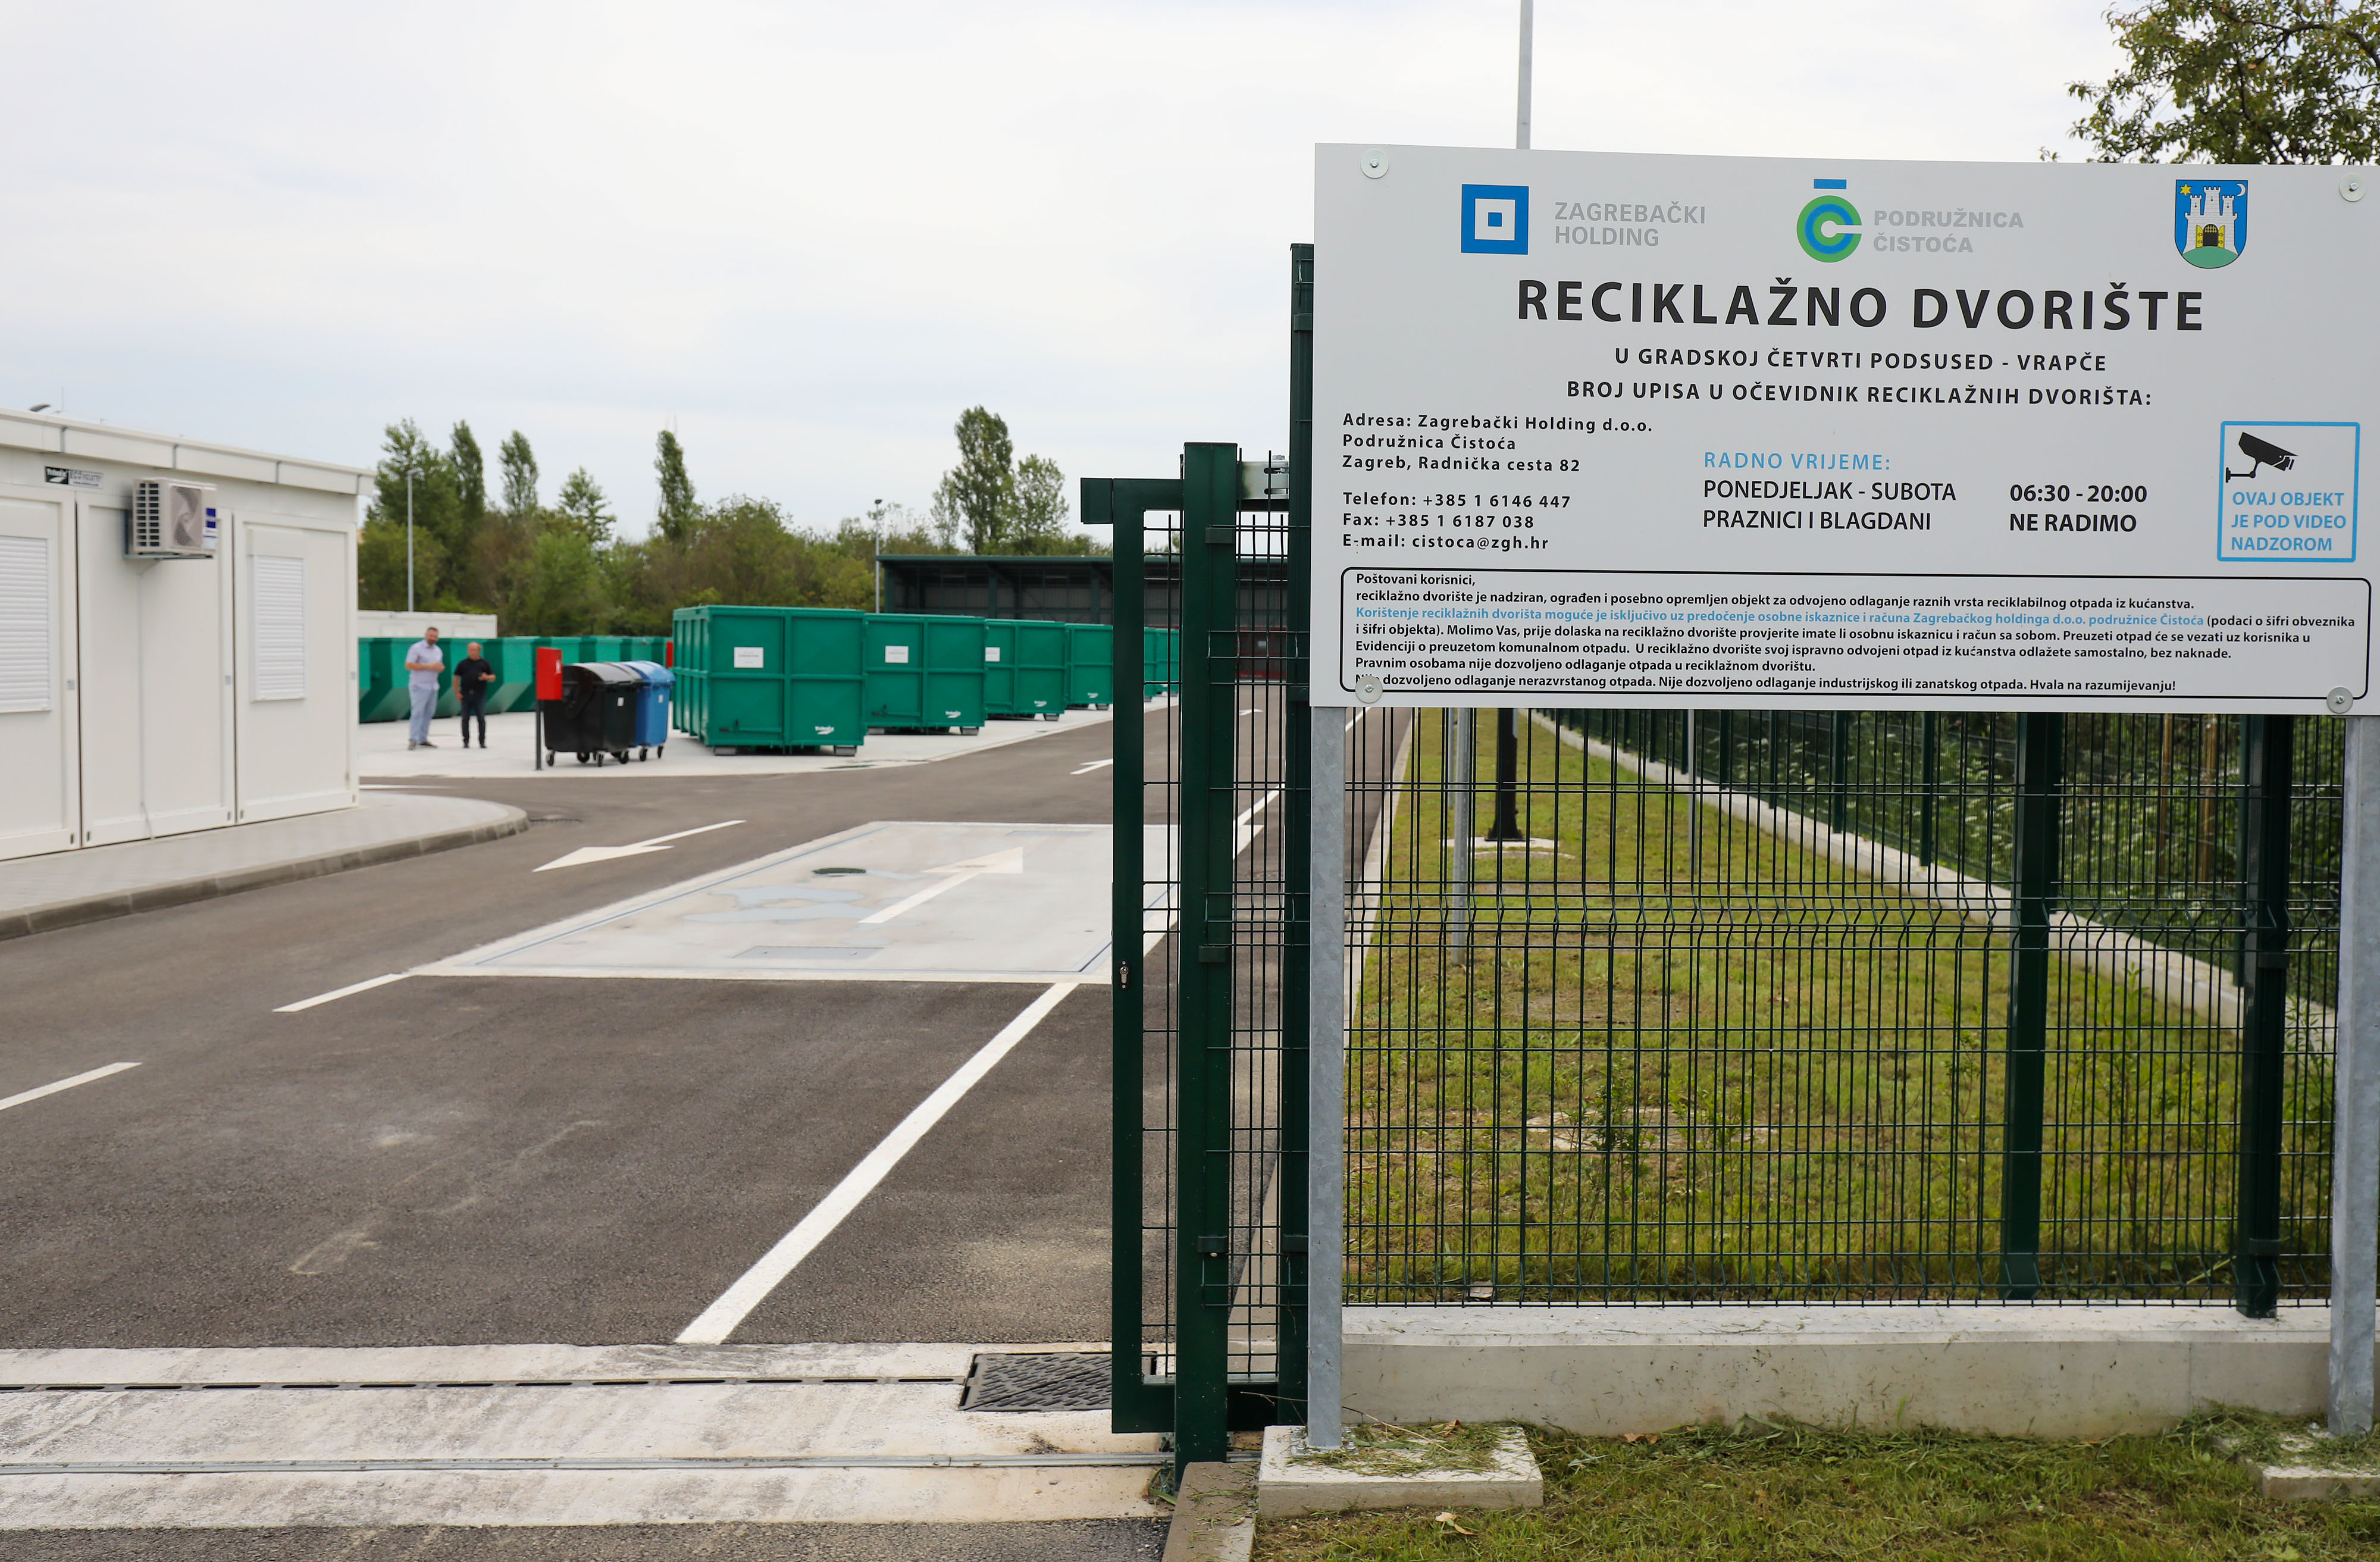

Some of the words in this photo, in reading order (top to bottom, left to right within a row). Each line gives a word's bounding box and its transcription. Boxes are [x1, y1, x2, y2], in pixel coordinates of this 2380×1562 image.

[1554, 201, 1705, 224] ZAGREBAČKI
[1874, 208, 2024, 228] PODRUŽNICA
[1555, 226, 1659, 247] HOLDING
[1873, 231, 1974, 253] ČISTOĆA
[1518, 278, 1887, 328] RECIKLAŽNO
[1914, 281, 2202, 331] DVORIŠTE
[1615, 348, 1629, 364] U
[1638, 348, 1758, 367] GRADSKOJ
[1767, 348, 1861, 368] ČETVRTI
[1871, 352, 1993, 370] PODSUSED
[2017, 352, 2106, 371] VRAPČE
[1567, 381, 1623, 398] BROJ
[1633, 382, 1700, 399] UPISA
[1709, 384, 1723, 400] U
[1732, 381, 1858, 402] OČEVIDNIK
[1868, 384, 2019, 404] RECIKLAŽNIH
[2029, 386, 2151, 406] DVORIŠTA:
[1342, 412, 1411, 427] Adresa:
[1417, 414, 1518, 431] Zagrebački
[1526, 417, 1595, 434] Holding
[1602, 418, 1652, 432] d.o.o.
[1343, 434, 1443, 449] Podružnica
[1451, 433, 1515, 450] Čistoća
[1342, 455, 1411, 472] Zagreb,
[1418, 456, 1500, 470] Radnička
[1507, 459, 1552, 471] cesta
[1559, 459, 1579, 472] 82
[1705, 452, 1783, 469] RADNO
[1790, 453, 1890, 471] VRIJEME:
[1704, 480, 1853, 500] PONEDJELJAK
[1871, 482, 1956, 500] SUBOTA
[2010, 484, 2070, 502] 06:30
[2087, 485, 2147, 503] 20:00
[2232, 492, 2276, 506] OVAJ
[2281, 492, 2345, 506] OBJEKT
[1342, 492, 1416, 506] Telefon:
[1423, 493, 1466, 506] +385
[1474, 494, 1480, 507] 1
[1489, 494, 1532, 508] 6146
[1539, 496, 1570, 508] 447
[1343, 513, 1379, 526] Fax:
[1386, 514, 1429, 527] +385
[1438, 515, 1443, 527] 1
[1452, 515, 1495, 528] 6187
[1502, 515, 1534, 528] 038
[1703, 509, 1802, 529] PRAZNICI
[1809, 511, 1814, 529] I
[1821, 511, 1930, 530] BLAGDANI
[2010, 514, 2038, 531] NE
[2045, 514, 2137, 533] RADIMO
[2231, 514, 2249, 528] JE
[2253, 514, 2290, 528] POD
[2294, 515, 2347, 529] VIDEO
[1343, 534, 1405, 547] E-mail:
[1412, 534, 1548, 552] cistoca@zgh.hr
[2232, 537, 2332, 551] NADZOROM
[1357, 573, 1417, 584] Poštovani
[1420, 574, 1476, 587] korisnici,
[1356, 590, 1420, 601] reciklažno
[1423, 590, 1473, 602] dvorište
[1475, 591, 1487, 605] je
[1490, 591, 1547, 604] nadziran,
[1550, 592, 1601, 606] ograđen
[1604, 593, 1608, 603] i
[1611, 593, 1664, 606] posebno
[1666, 593, 1728, 607] opremljen
[1731, 594, 1771, 608] objekt
[1789, 594, 1846, 608] odvojeno
[1849, 595, 1910, 609] odlaganje
[1913, 596, 1950, 607] raznih
[1953, 597, 1984, 607] vrsta
[1987, 596, 2066, 611] reciklabilnog
[2069, 597, 2113, 611] otpada
[2116, 597, 2126, 608] iz
[2129, 597, 2194, 609] kućanstva.
[1356, 607, 1419, 621] Korištenje
[1422, 608, 1489, 619] reciklažnih
[1492, 608, 1542, 619] dvorišta
[1545, 609, 1593, 622] moguće
[1595, 609, 1607, 622] je
[1610, 609, 1667, 623] isključivo
[1687, 610, 1755, 624] predočenje
[1758, 611, 1802, 622] osobne
[1805, 611, 1860, 622] iskaznice
[1863, 612, 1866, 622] i
[1869, 612, 1910, 623] računa
[1913, 612, 1993, 626] Zagrebačkog
[1996, 613, 2050, 627] holdinga
[2053, 613, 2085, 624] d.o.o.
[2089, 613, 2157, 627] podružnice
[2160, 613, 2204, 625] Čistoća
[2207, 615, 2252, 628] (podaci
[2266, 615, 2289, 626] šifri
[2292, 615, 2355, 627] obveznika
[1356, 623, 1359, 634] i
[1363, 623, 1386, 634] šifri
[1389, 624, 1444, 637] objekta).
[1447, 624, 1493, 636] Molimo
[1496, 625, 1520, 637] Vas,
[1523, 625, 1551, 638] prije
[1554, 625, 1601, 637] dolaska
[1605, 628, 1619, 637] na
[1623, 626, 1684, 637] reciklažno
[1687, 627, 1737, 638] dvorište
[1740, 627, 1799, 641] provjerite
[1802, 628, 1836, 638] imate
[1839, 628, 1846, 638] li
[1849, 628, 1894, 639] osobnu
[1897, 628, 1953, 640] iskaznicu
[1956, 629, 1959, 640] i
[1963, 629, 1996, 640] račun
[1999, 632, 2012, 640] sa
[2015, 630, 2060, 640] sobom.
[2063, 630, 2113, 641] Preuzeti
[2116, 631, 2152, 644] otpad
[2154, 631, 2168, 641] će
[2187, 631, 2223, 642] vezati
[2243, 631, 2299, 643] korisnika
[1355, 657, 1407, 668] Pravnim
[1410, 658, 1465, 669] osobama
[1469, 658, 1492, 671] nije
[1494, 658, 1562, 672] dozvoljeno
[1565, 659, 1626, 672] odlaganje
[1629, 659, 1672, 673] otpada
[1675, 662, 1682, 671] u
[1686, 660, 1759, 671] reciklažnom
[1762, 660, 1815, 671] dvorištu.
[1383, 674, 1451, 688] dozvoljeno
[1454, 674, 1516, 688] odlaganje
[1518, 677, 1606, 689] nerazvrstanog
[1609, 676, 1656, 689] otpada.
[1659, 676, 1683, 690] Nije
[1686, 676, 1753, 690] dozvoljeno
[1755, 677, 1816, 690] odlaganje
[1819, 677, 1898, 691] industrijskog
[1902, 678, 1912, 688] ili
[1915, 678, 1977, 692] zanatskog
[1980, 678, 2027, 692] otpada.
[2030, 679, 2064, 690] Hvala
[2067, 682, 2082, 690] na
[2085, 680, 2175, 693] razumijevanju!
